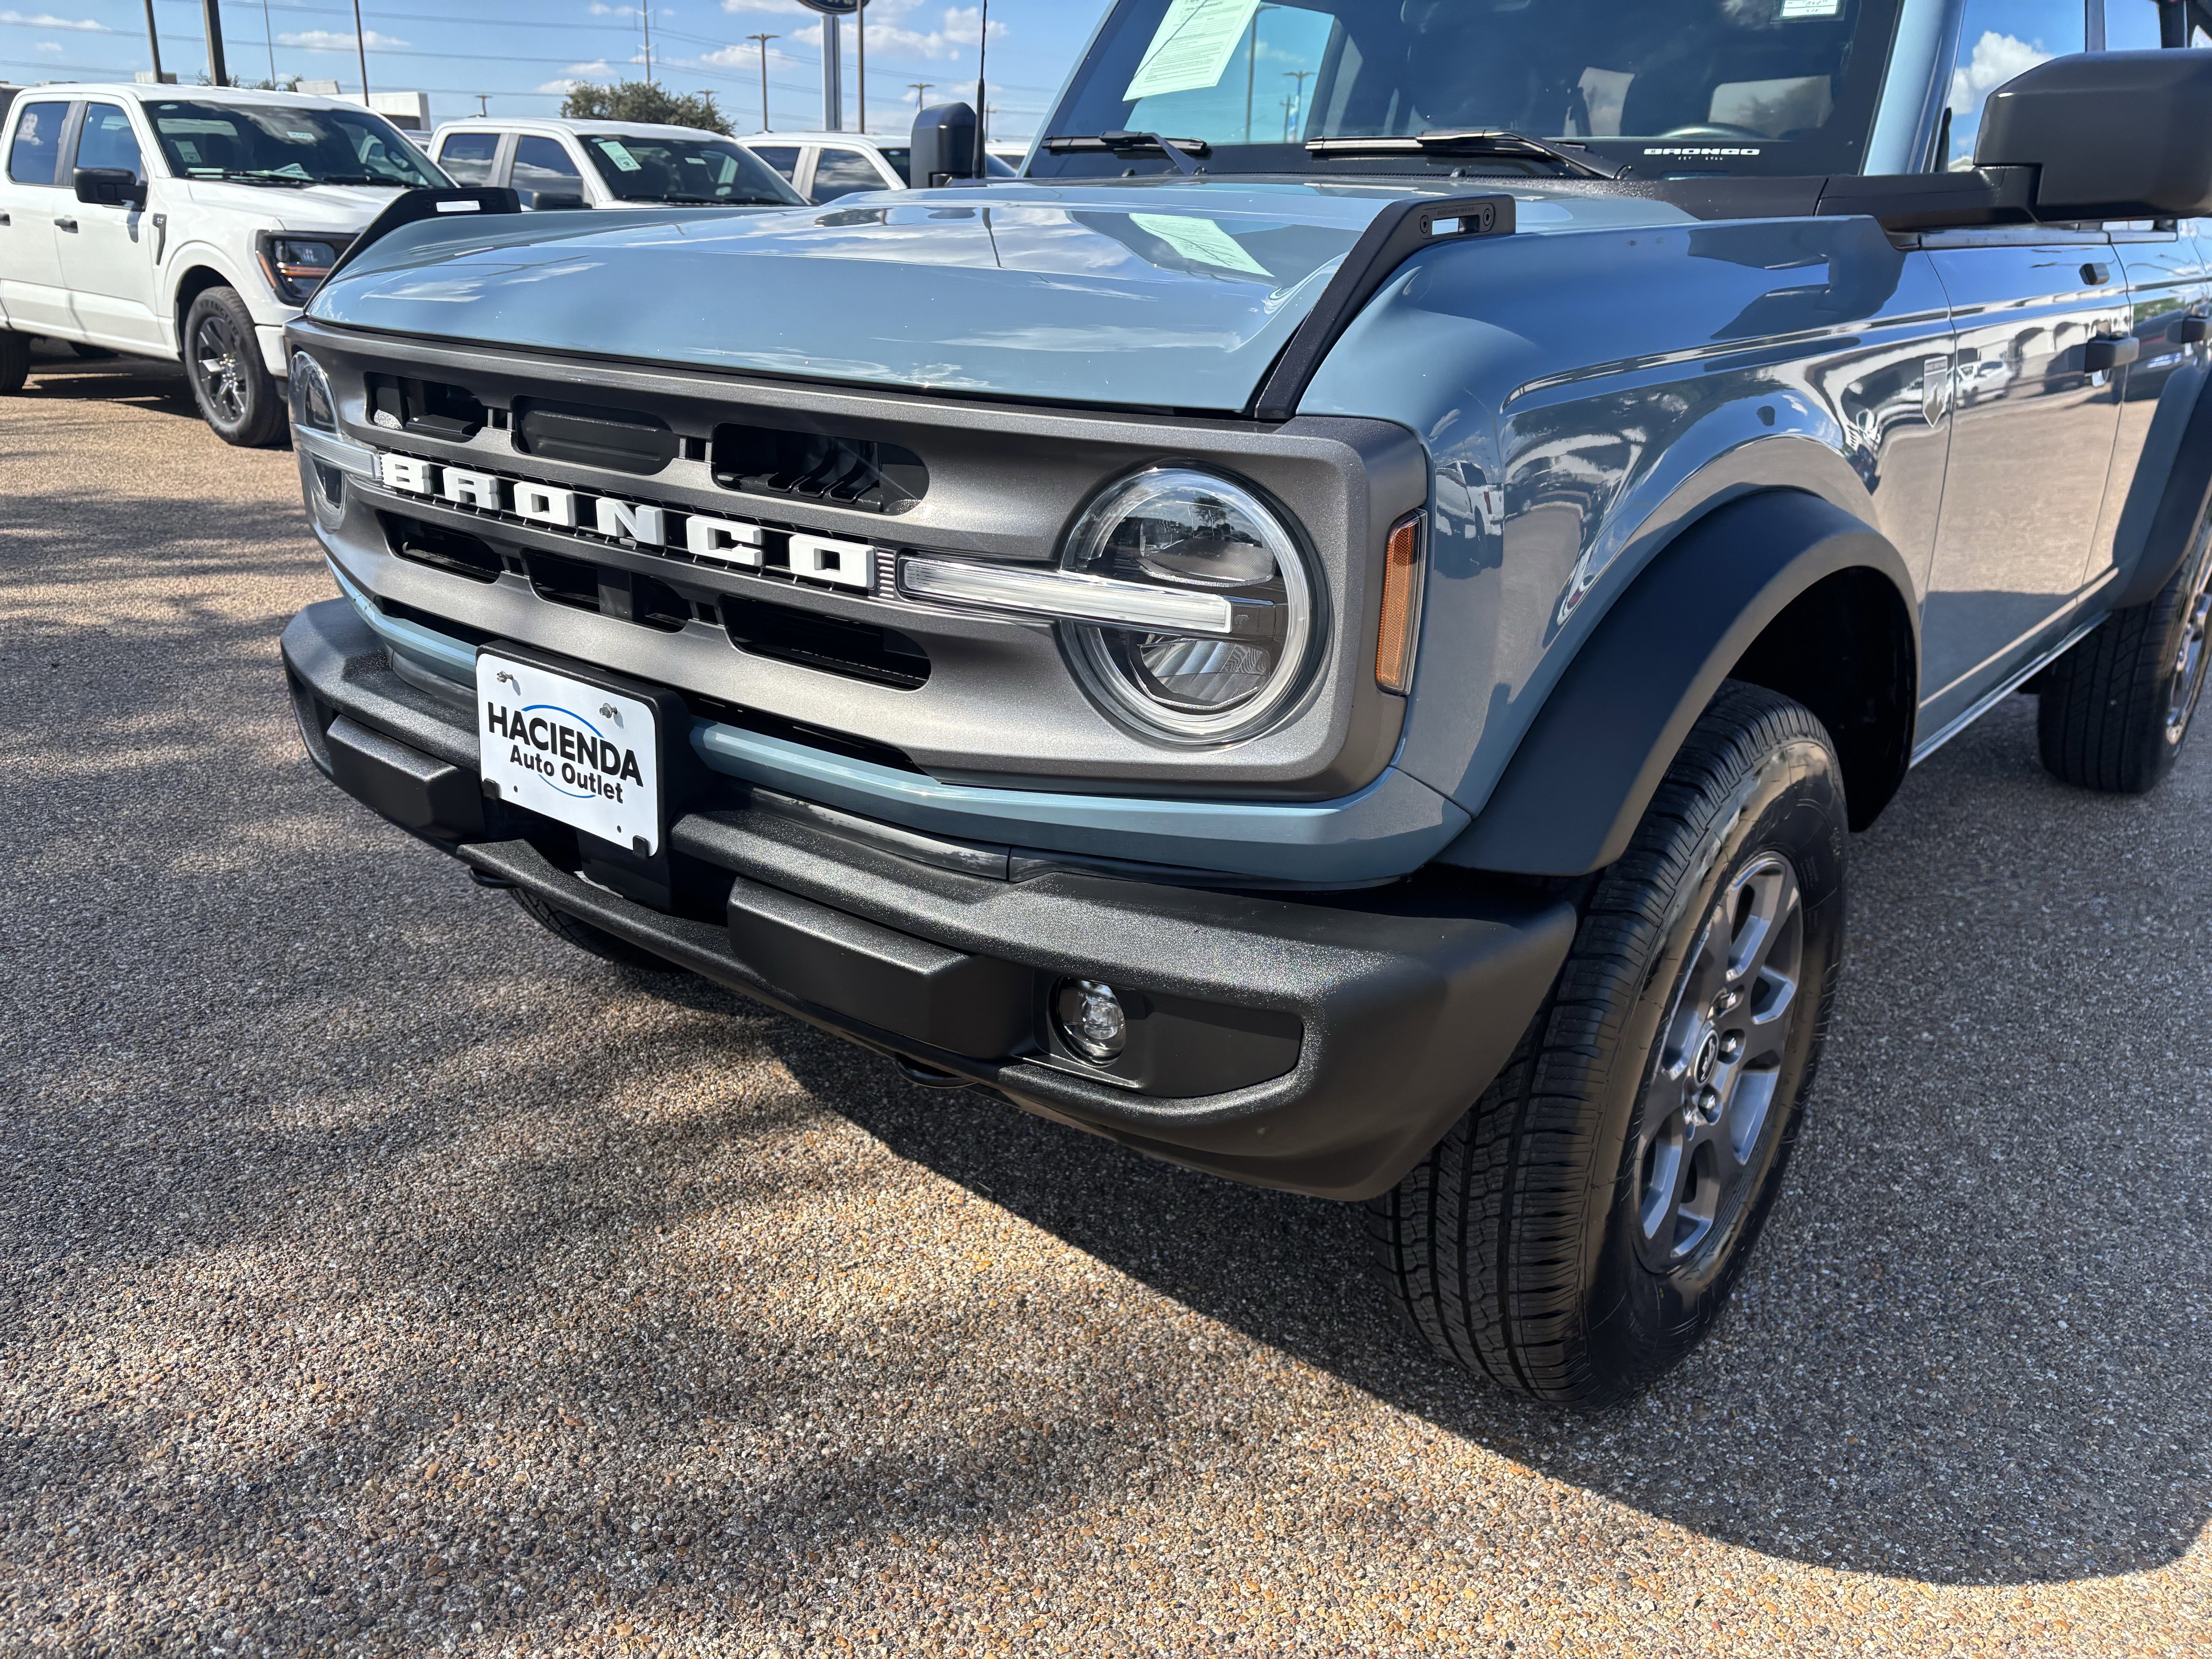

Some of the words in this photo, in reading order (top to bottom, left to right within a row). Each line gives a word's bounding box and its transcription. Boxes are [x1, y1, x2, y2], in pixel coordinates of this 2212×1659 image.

[381, 453, 876, 589] BRONCO
[488, 701, 644, 787] HACIENDA
[510, 745, 555, 777] Auto
[562, 763, 623, 804] Outlet
